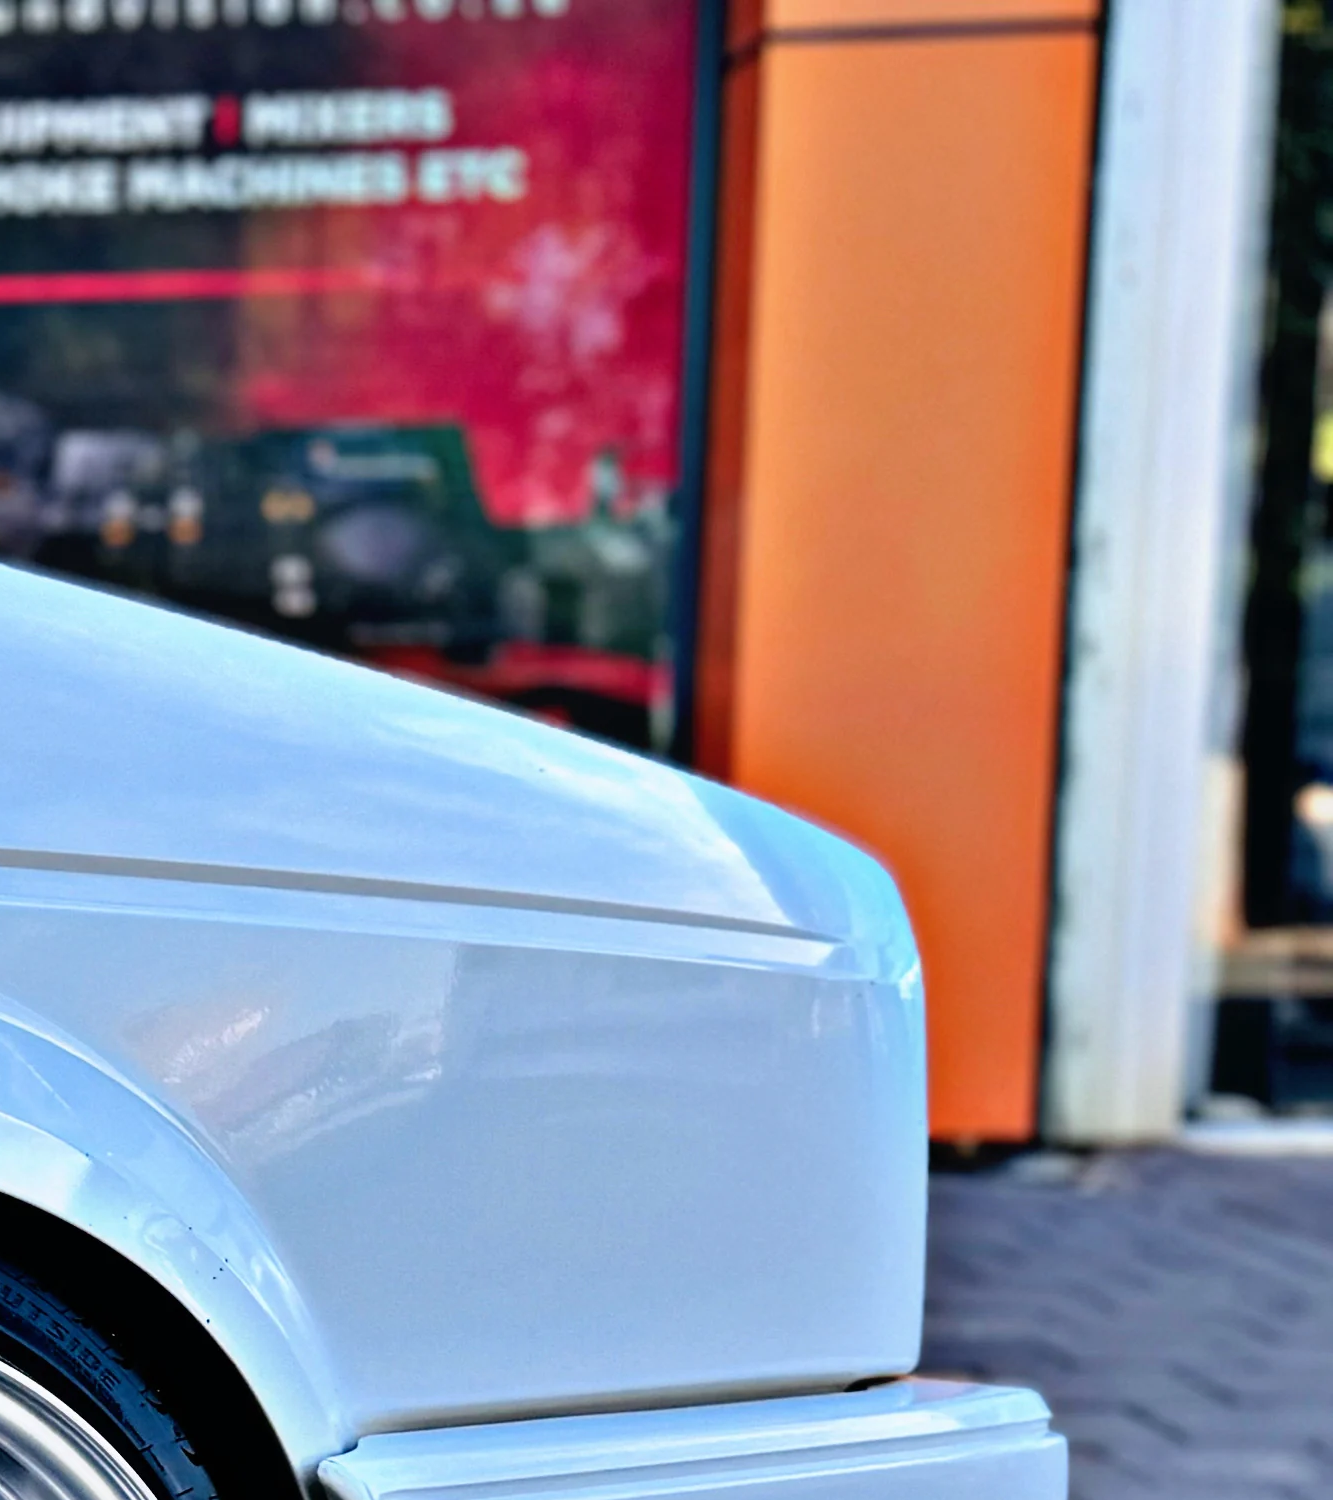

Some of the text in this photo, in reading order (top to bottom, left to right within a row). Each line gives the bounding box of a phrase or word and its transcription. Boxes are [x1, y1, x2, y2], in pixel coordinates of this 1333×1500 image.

[244, 90, 454, 144] MIXERS
[128, 152, 408, 211] MACHINES
[417, 147, 528, 202] ETC
